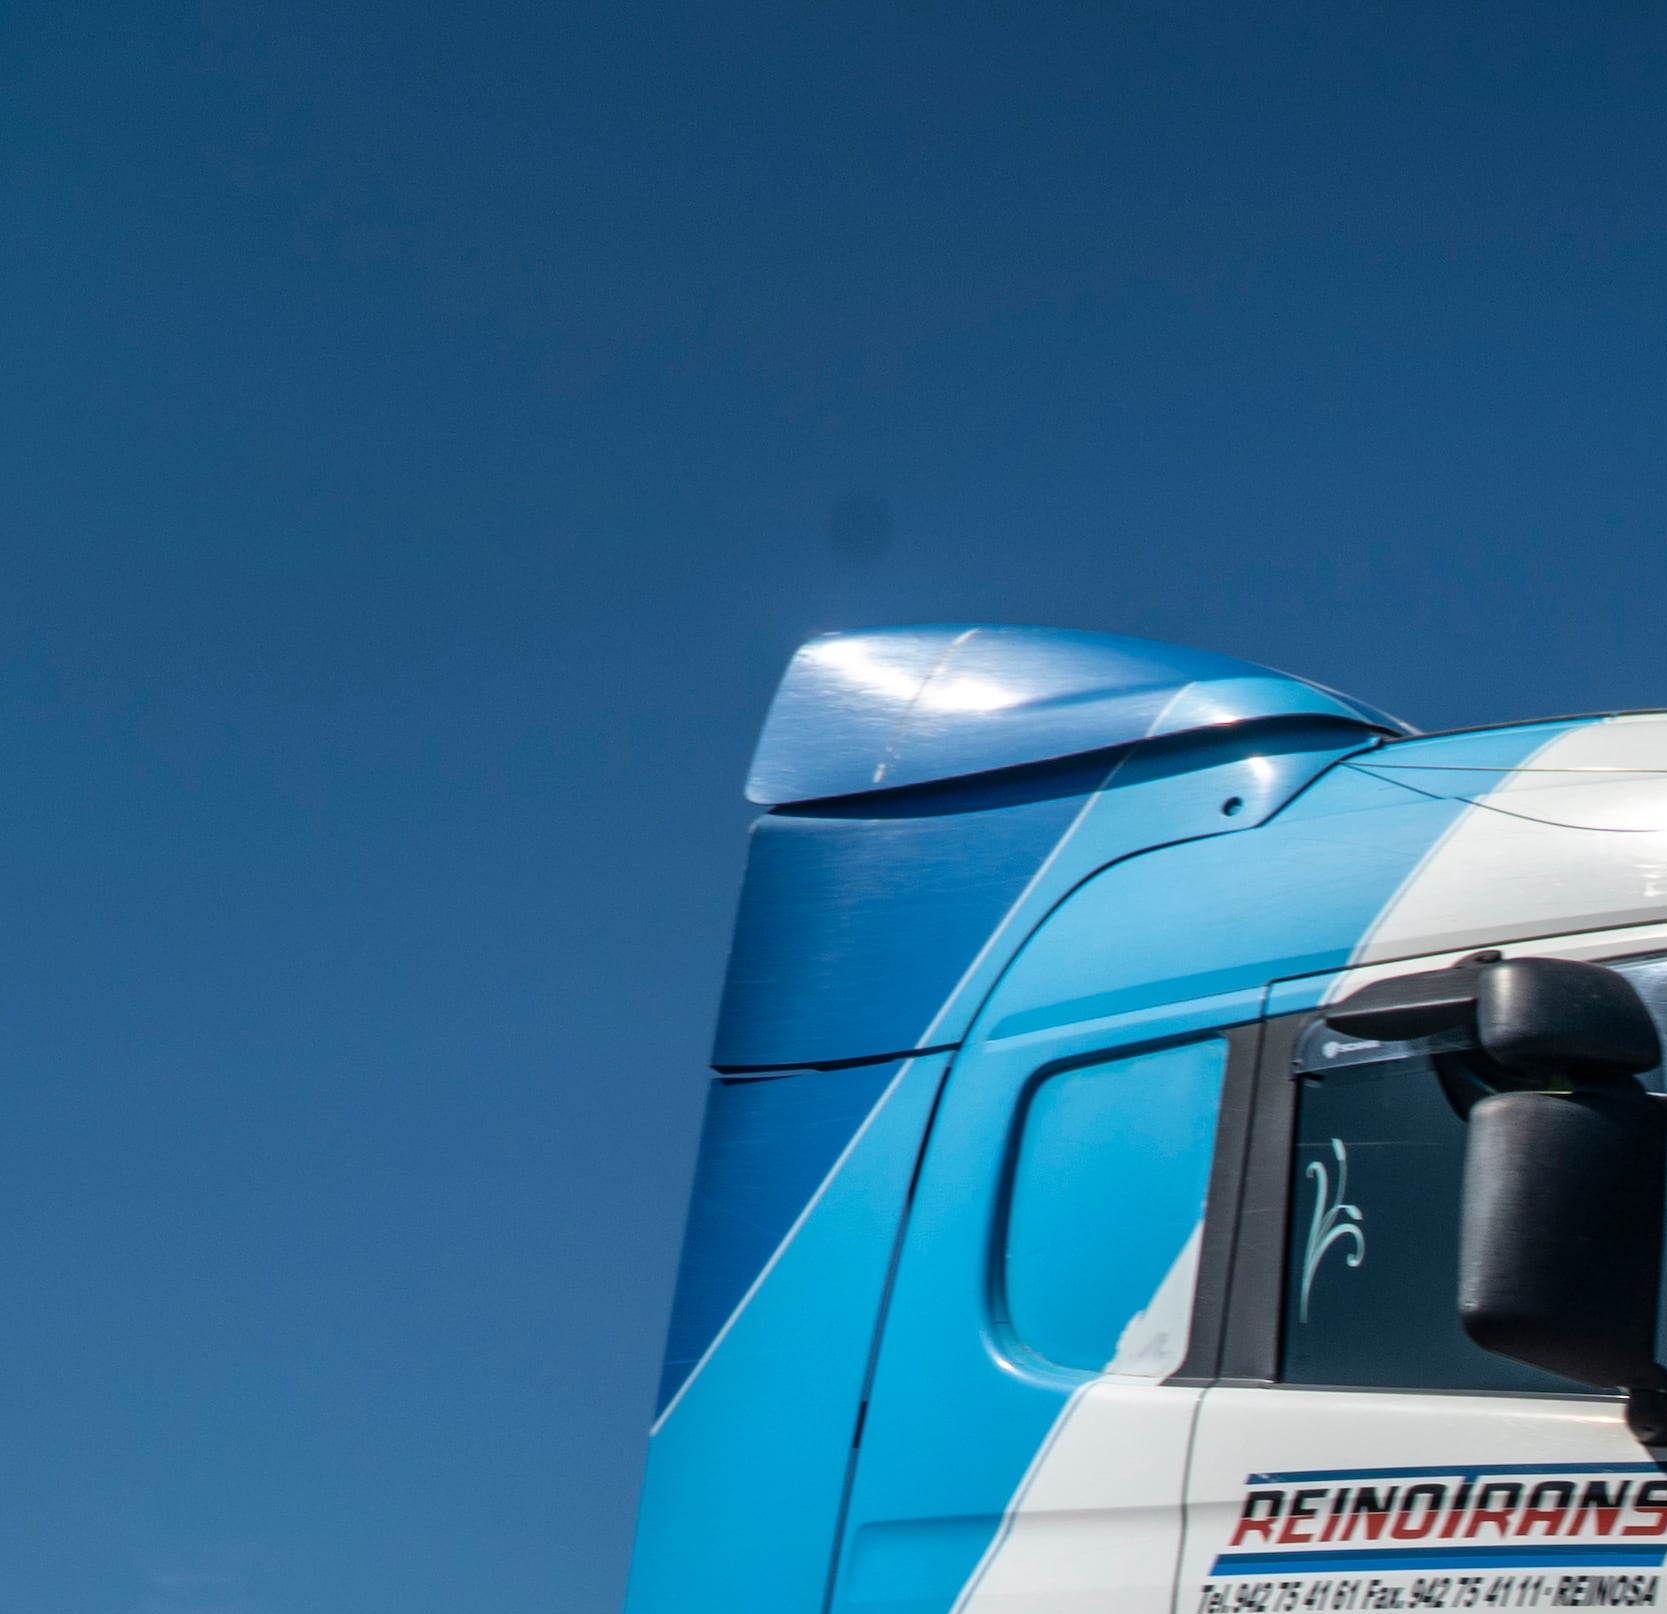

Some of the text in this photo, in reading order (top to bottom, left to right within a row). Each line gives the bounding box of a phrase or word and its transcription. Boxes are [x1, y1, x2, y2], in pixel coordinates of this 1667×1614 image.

[1273, 1581, 1302, 1612] 75
[1304, 1580, 1332, 1610] 41
[1333, 1579, 1361, 1610] 61
[1450, 1577, 1484, 1608] 75
[1486, 1576, 1515, 1607] 41
